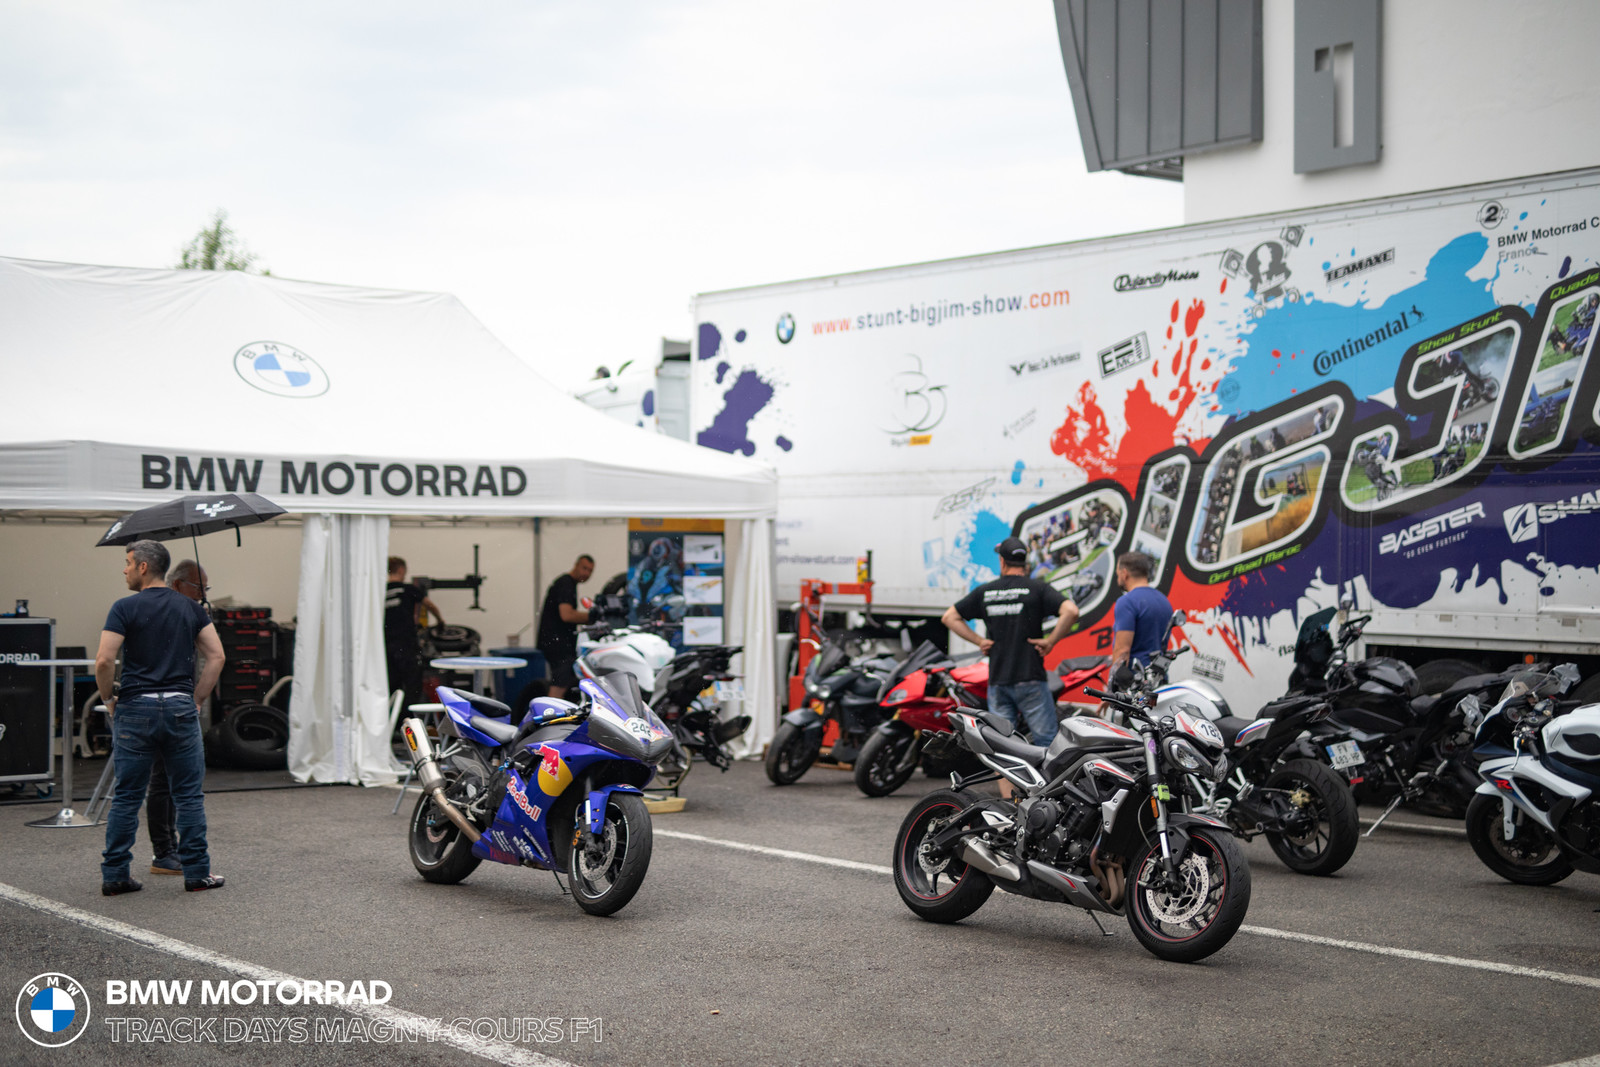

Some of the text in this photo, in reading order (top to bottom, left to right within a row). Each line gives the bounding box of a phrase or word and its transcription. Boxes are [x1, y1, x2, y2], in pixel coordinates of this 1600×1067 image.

[1497, 232, 1528, 248] BMW
[1532, 219, 1587, 241] Motorrad
[1498, 246, 1539, 260] France
[1550, 272, 1600, 300] Quads
[812, 289, 1070, 335] www.stunt-bigjim-show.com
[1417, 310, 1503, 356] Show Stunt
[1313, 312, 1410, 376] Continental
[142, 454, 527, 497] BMW MOTORRAD
[1379, 501, 1486, 555] BAGSTER
